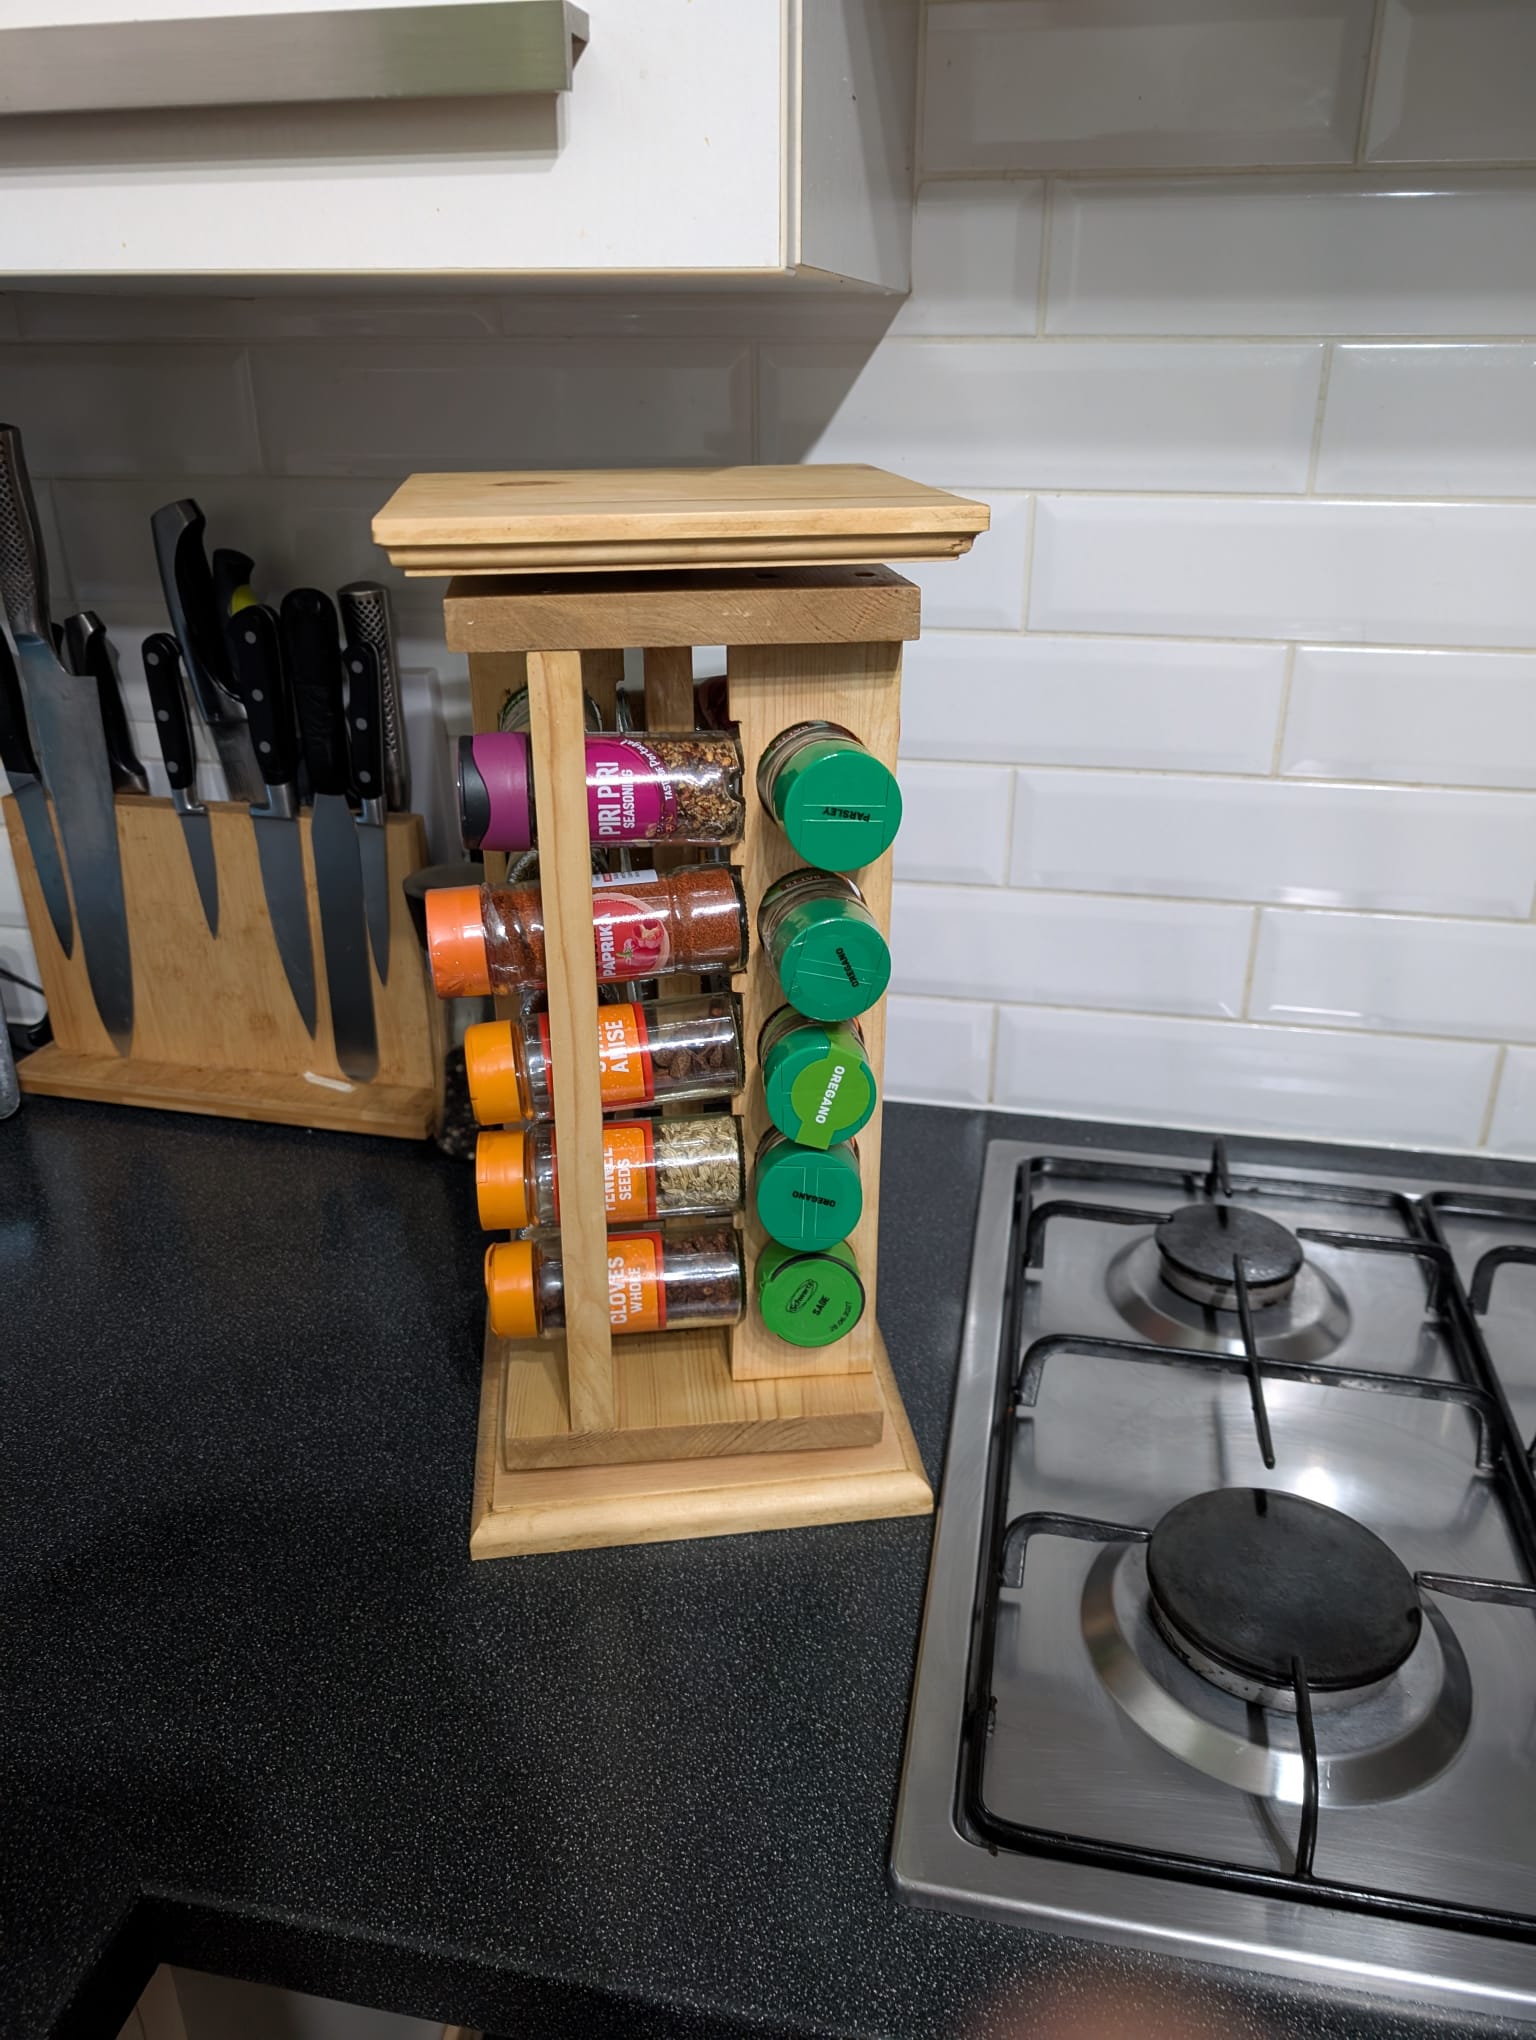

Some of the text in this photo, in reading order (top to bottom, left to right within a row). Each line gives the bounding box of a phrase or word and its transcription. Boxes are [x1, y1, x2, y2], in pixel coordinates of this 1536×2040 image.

[596, 762, 620, 836] PIRI PRI
[621, 769, 634, 828] SEASONIG
[660, 775, 673, 801] TAST
[822, 806, 871, 823] PARSLEY
[835, 947, 860, 988] OREGANO
[815, 1065, 846, 1124] OREGANO
[617, 1158, 631, 1200] SEEDS
[792, 1190, 837, 1208] OREGANO
[608, 1256, 627, 1324] CLOVES
[628, 1266, 642, 1314] WHOLE
